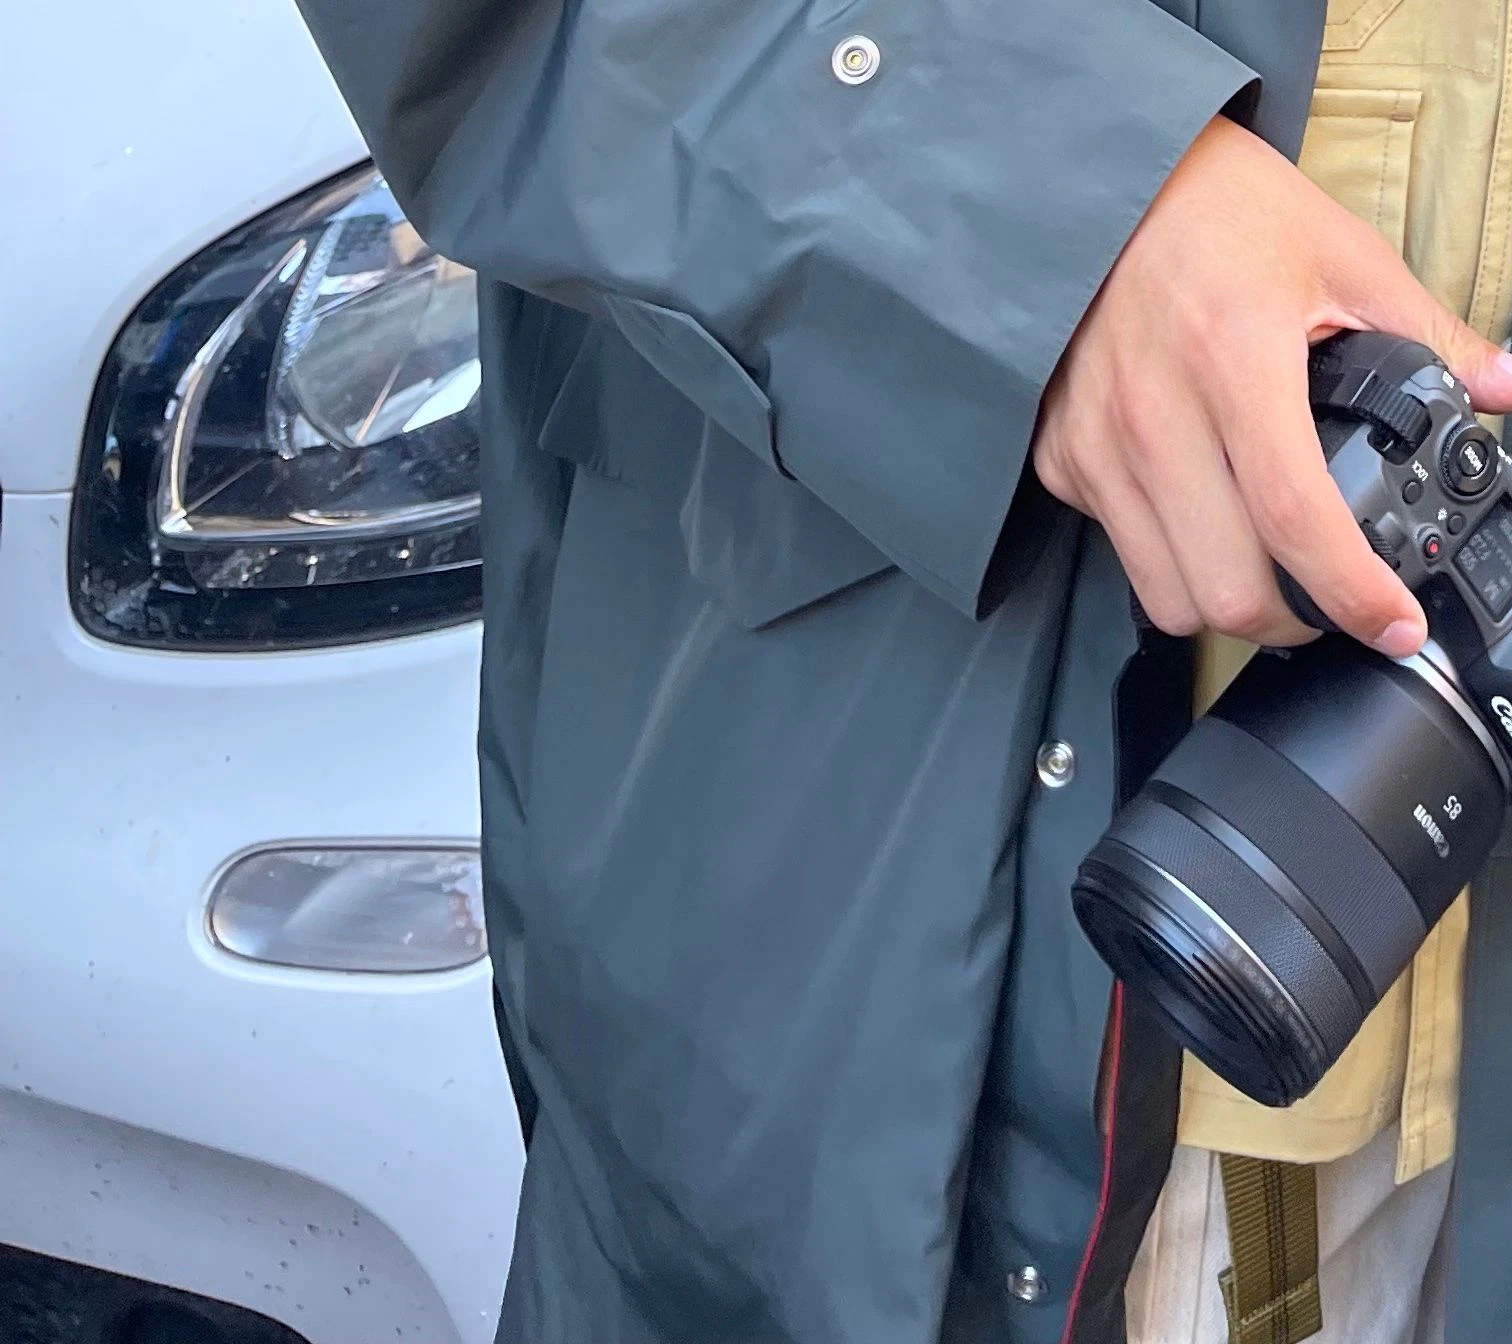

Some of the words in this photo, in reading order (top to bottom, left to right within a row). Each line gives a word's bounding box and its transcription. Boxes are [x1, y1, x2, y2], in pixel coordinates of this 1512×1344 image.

[1411, 459, 1429, 482] LOCK
[1442, 795, 1463, 821] 85
[1412, 803, 1450, 858] Canon
